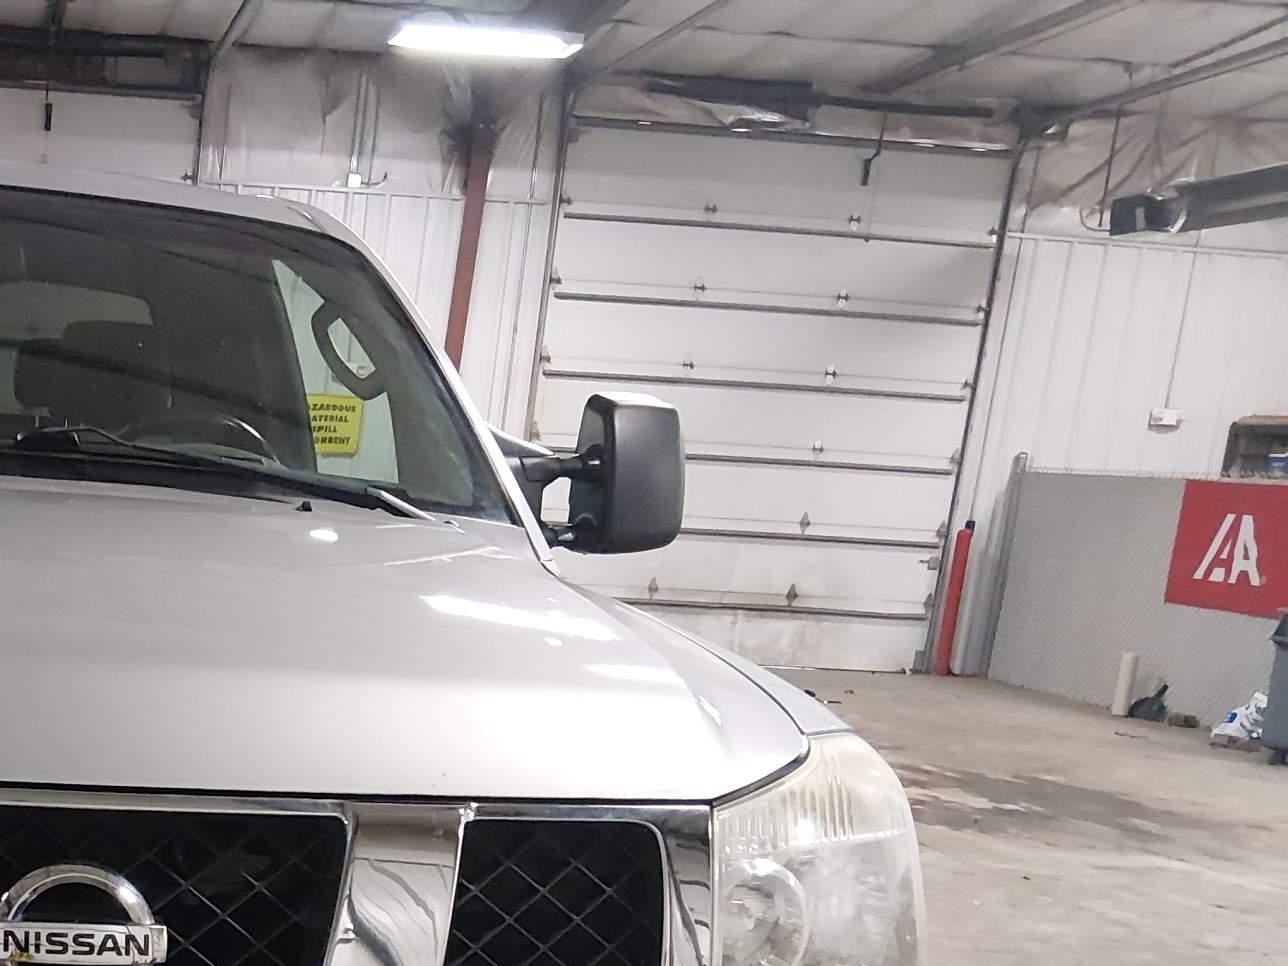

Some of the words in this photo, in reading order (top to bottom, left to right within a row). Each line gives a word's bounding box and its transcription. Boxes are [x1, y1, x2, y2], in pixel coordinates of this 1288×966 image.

[309, 403, 356, 413] ZARDOUS
[312, 414, 349, 423] ATERIAL
[314, 436, 351, 445] ORBENT
[3, 930, 150, 956] NISSAN
